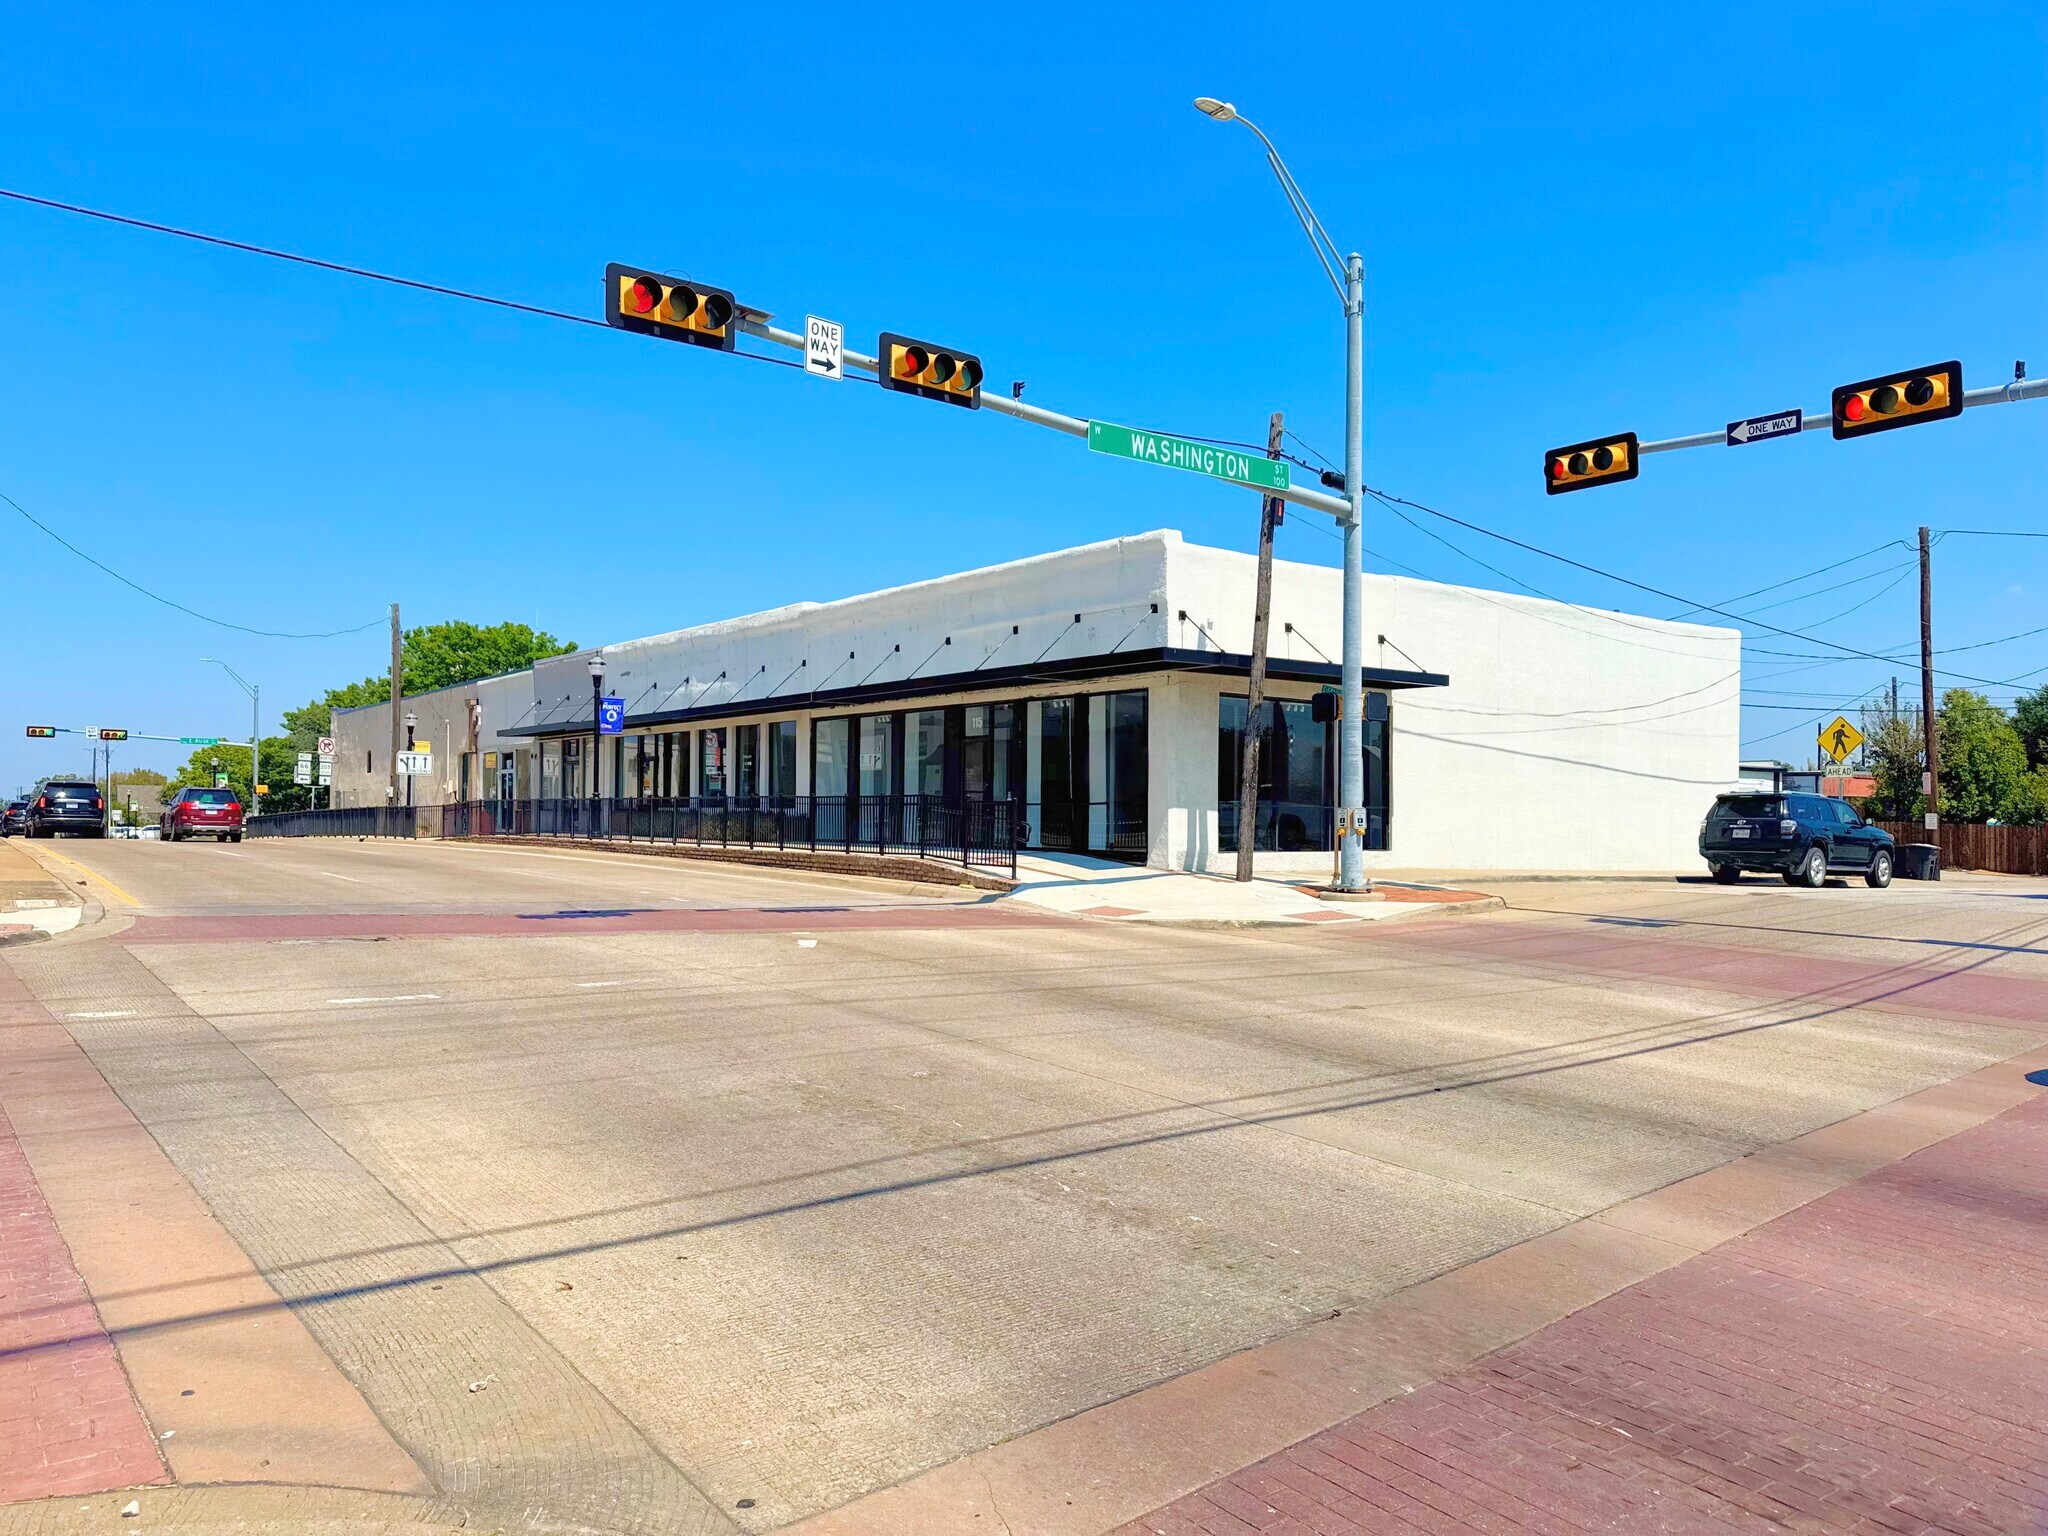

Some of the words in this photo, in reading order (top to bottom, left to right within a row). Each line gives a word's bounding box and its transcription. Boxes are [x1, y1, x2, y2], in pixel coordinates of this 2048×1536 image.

[811, 322, 838, 341] ONE
[810, 337, 839, 356] WAY
[1748, 423, 1768, 435] ONE
[1772, 417, 1793, 431] WAY
[1094, 424, 1101, 435] W
[1131, 433, 1249, 480] WASHINGTON
[1275, 464, 1284, 475] ST
[1273, 476, 1286, 487] 100
[972, 716, 983, 729] 115
[1827, 767, 1852, 776] AHEAD
